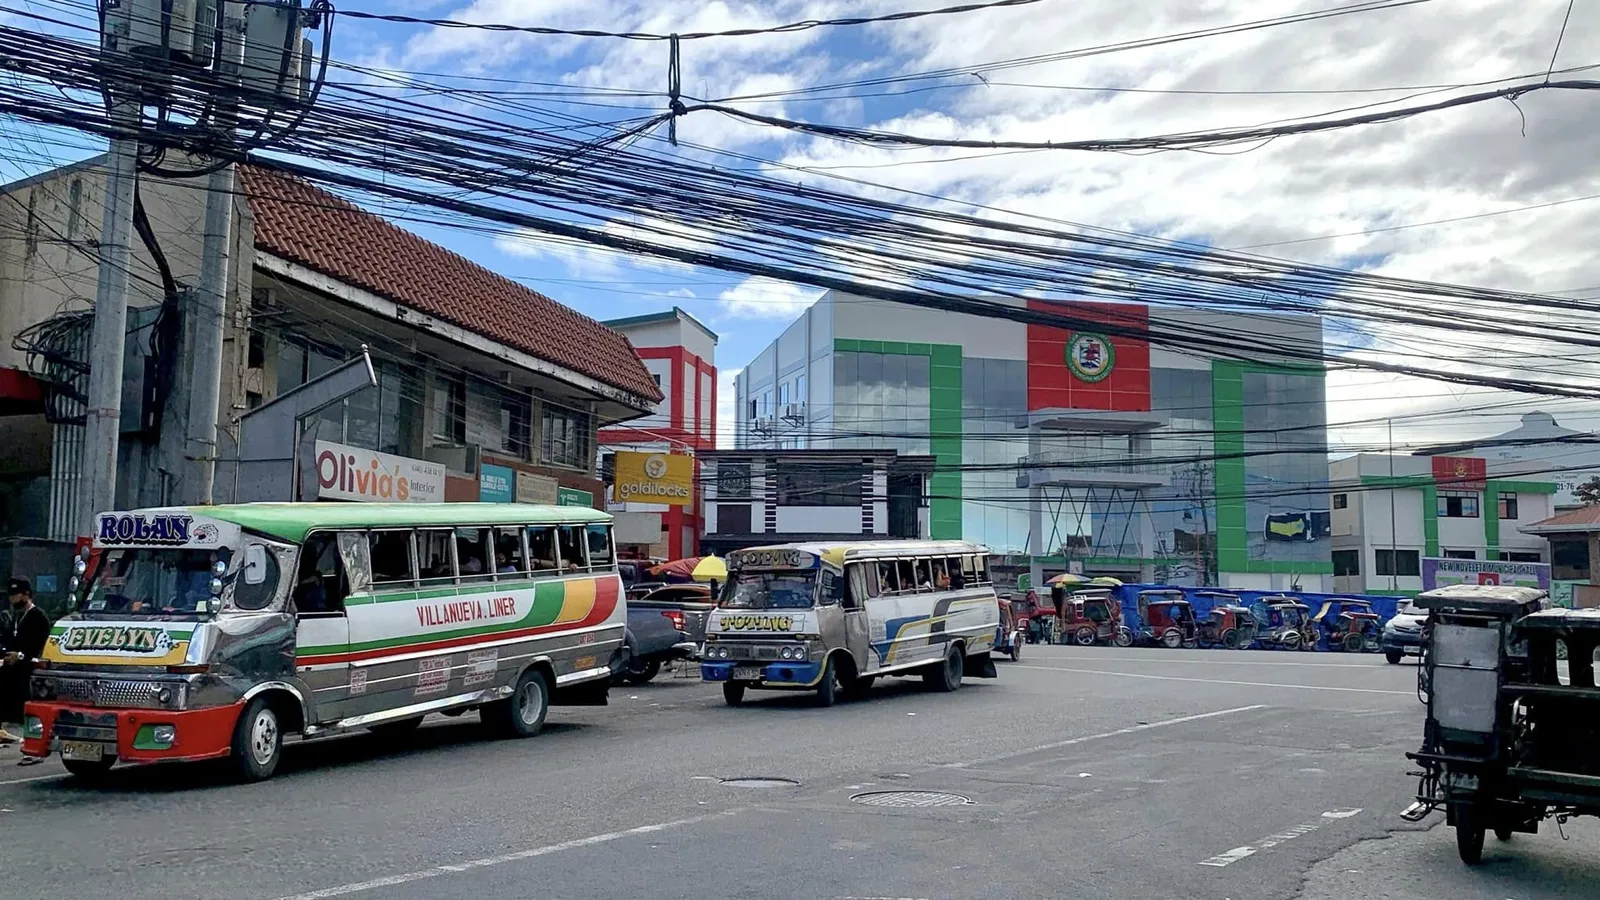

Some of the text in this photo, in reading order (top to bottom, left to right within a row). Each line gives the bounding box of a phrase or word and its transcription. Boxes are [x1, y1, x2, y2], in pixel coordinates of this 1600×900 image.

[317, 450, 409, 500] Olivia's
[410, 479, 436, 493] Interior
[620, 482, 689, 499] goldilocks
[100, 515, 194, 543] ROLAN
[1440, 561, 1453, 571] NEW
[1454, 561, 1487, 573] NOVELETA
[487, 596, 516, 618] LINER
[67, 627, 163, 651] EVELYN
